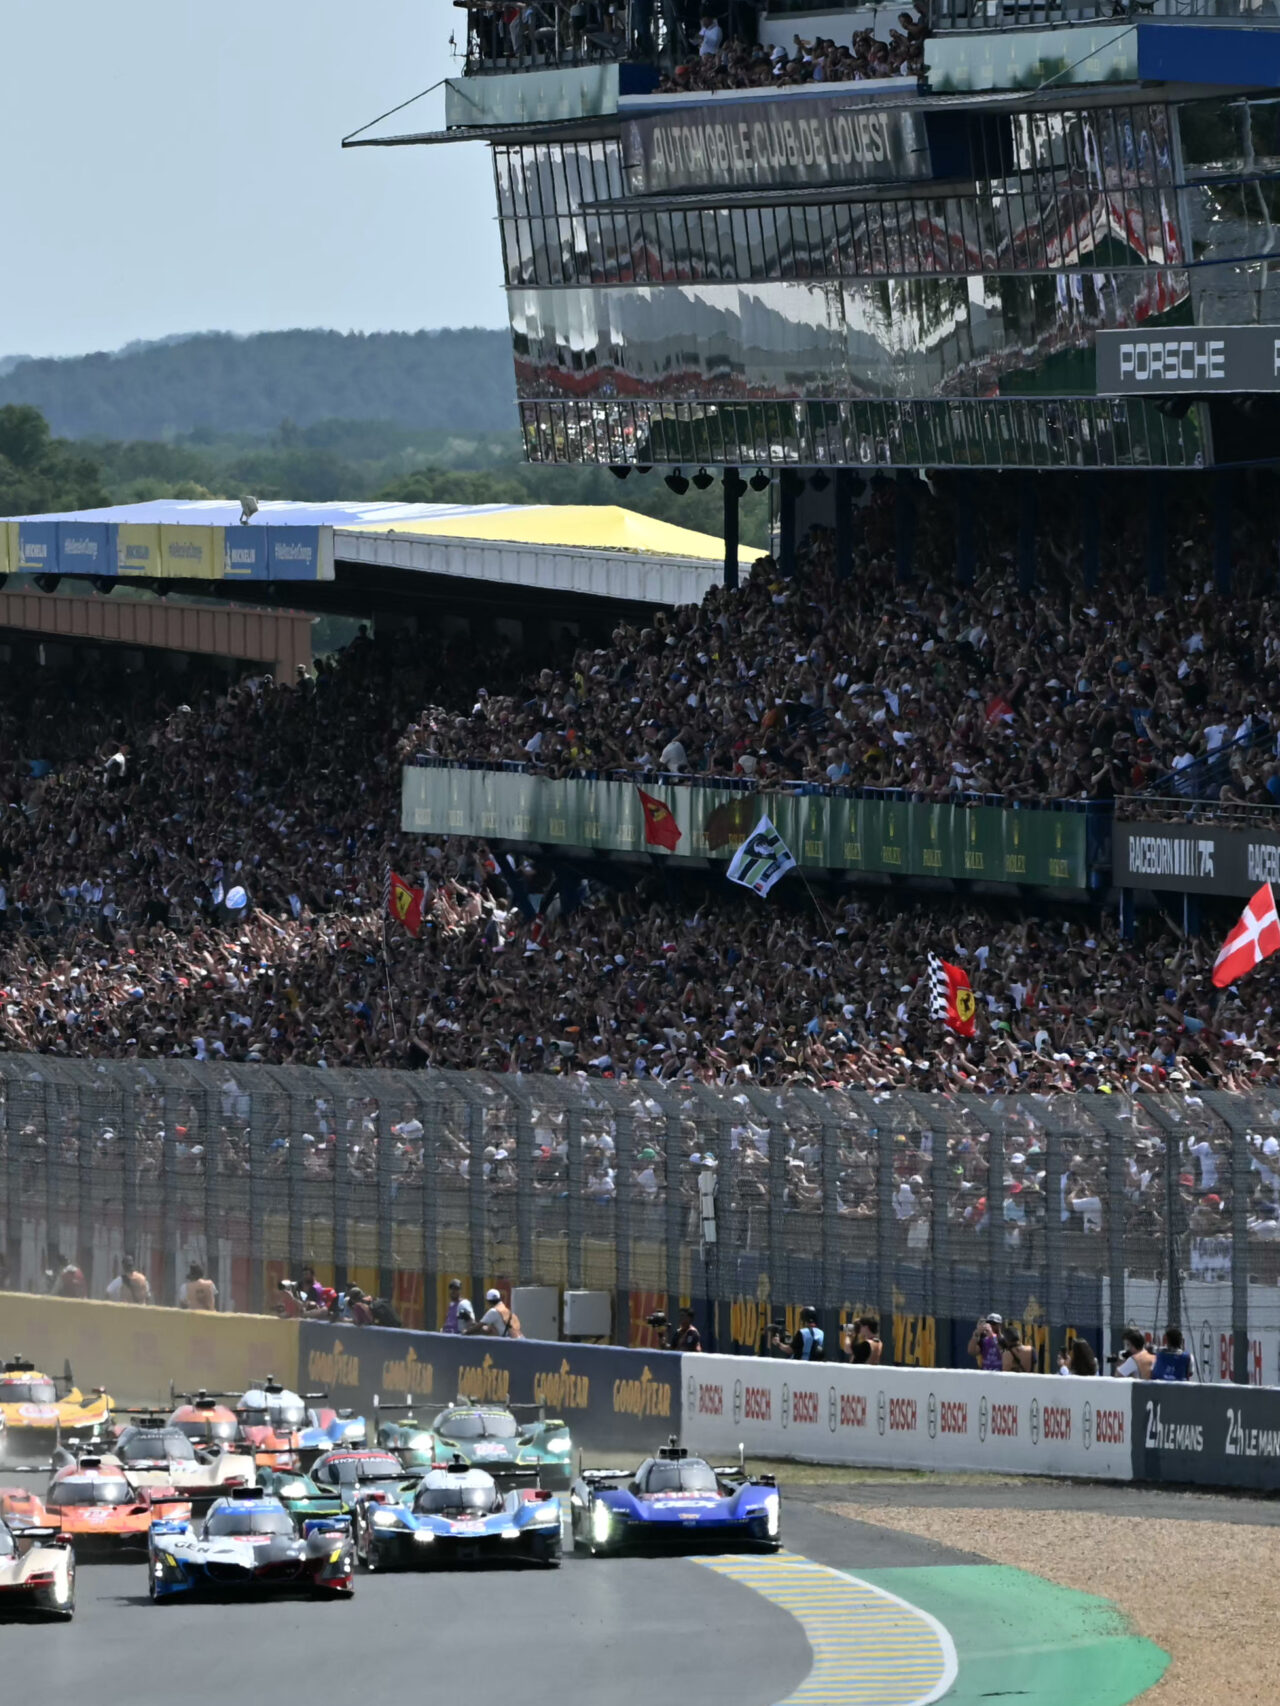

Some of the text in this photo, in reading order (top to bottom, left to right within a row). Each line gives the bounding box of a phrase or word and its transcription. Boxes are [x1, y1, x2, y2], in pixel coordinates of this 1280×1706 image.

[653, 112, 891, 172] AUTOMOBILE CLUB DE L'OUEST
[1120, 340, 1225, 381] PORSCHE
[1129, 835, 1173, 875] RACEBORN
[534, 1372, 589, 1409] GOODYEAR
[613, 1378, 672, 1417] GOODYEAR
[699, 1384, 723, 1415] BOSCH
[745, 1387, 771, 1419] BOSCH
[793, 1391, 819, 1423] BOSCH
[840, 1394, 867, 1427] BOSCH
[889, 1398, 916, 1430] BOSCH
[941, 1402, 967, 1433] BOSCH
[992, 1404, 1018, 1437] BOSCH
[1043, 1406, 1071, 1440] BOSCH
[1096, 1409, 1124, 1444] BOSCH
[1164, 1423, 1175, 1449] LE
[1176, 1424, 1203, 1451] MANS
[1245, 1428, 1258, 1456] LE
